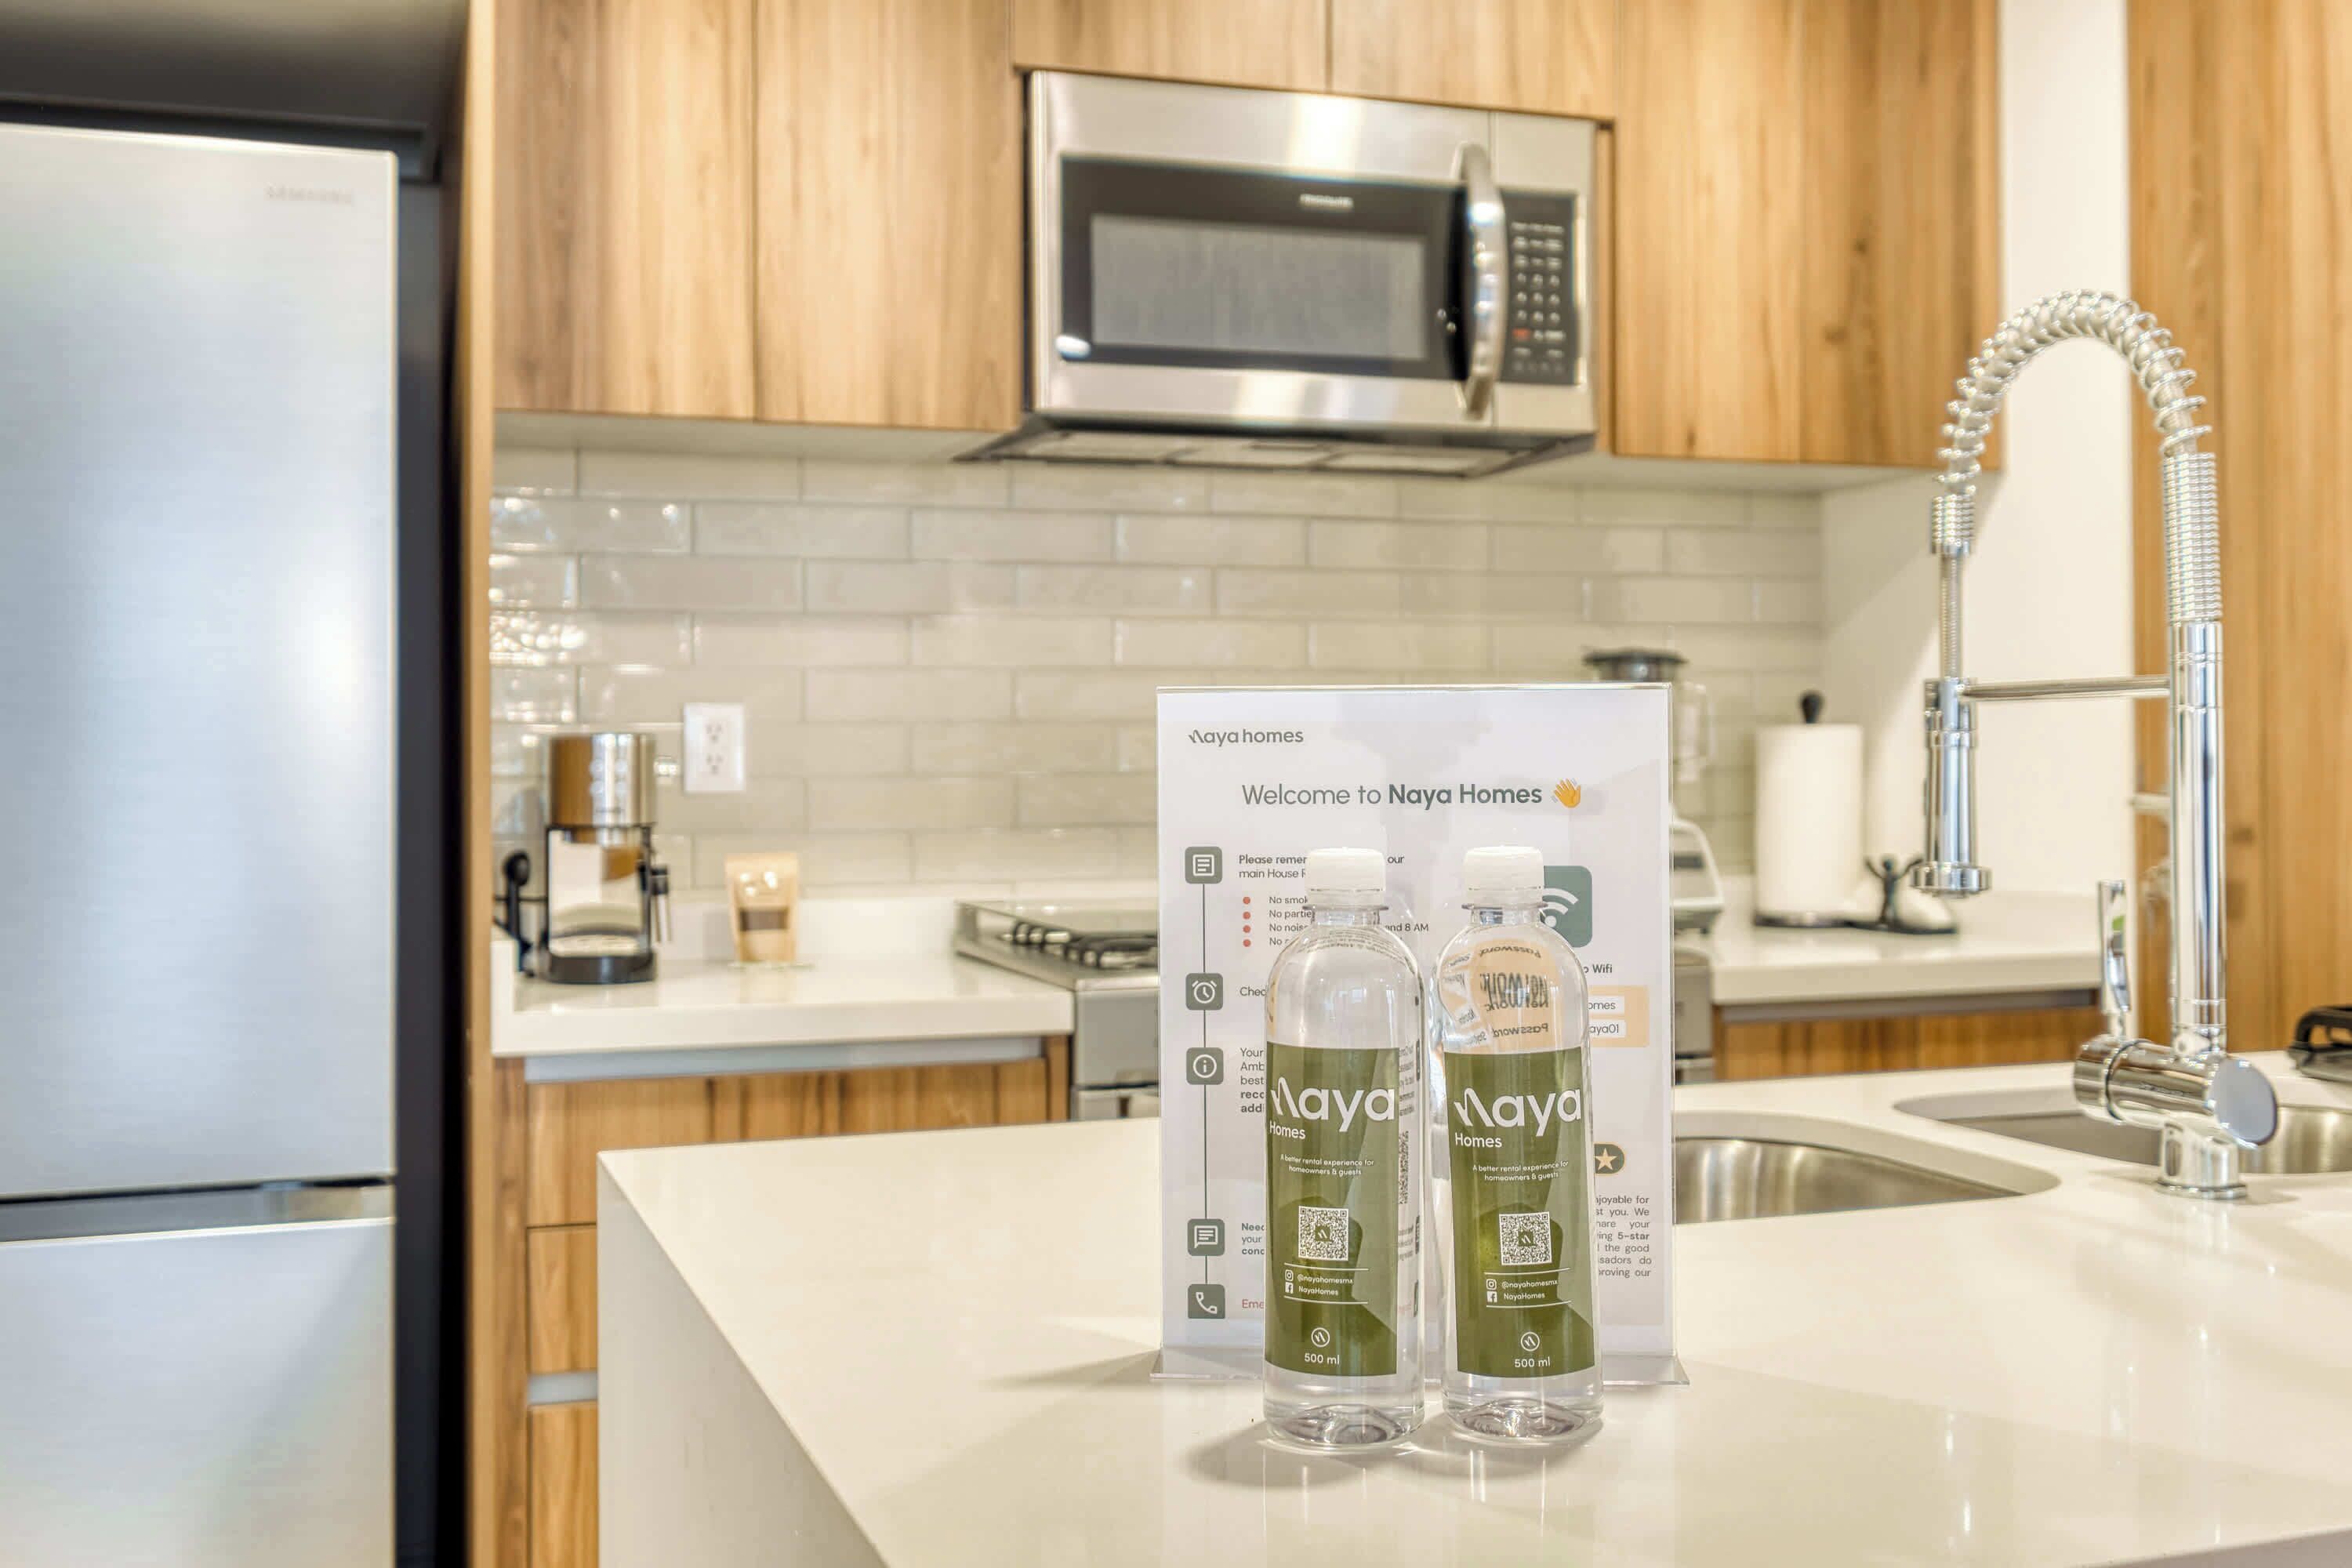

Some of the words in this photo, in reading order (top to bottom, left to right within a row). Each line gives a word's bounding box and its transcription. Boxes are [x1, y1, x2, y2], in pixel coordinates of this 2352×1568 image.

[1242, 728, 1304, 743] homes
[1242, 783, 1350, 805] Welcome
[1358, 785, 1381, 804] to
[1388, 784, 1452, 811] Naya
[1460, 784, 1543, 804] Homes
[1239, 854, 1273, 865] Please
[1239, 869, 1265, 878] main
[1268, 869, 1299, 878] House
[1269, 909, 1282, 918] No
[1404, 923, 1411, 931] 8
[1414, 923, 1429, 931] AM
[1269, 937, 1283, 946] No
[1592, 964, 1613, 974] Wifi
[1240, 1047, 1265, 1058] Your
[1240, 1075, 1265, 1085] best
[1269, 1120, 1306, 1140] Homes
[1455, 1132, 1503, 1148] Homes
[1285, 1154, 1301, 1163] better
[1289, 1165, 1330, 1175] homeowners
[1338, 1168, 1362, 1178] guests
[1523, 1163, 1559, 1171] experience
[1538, 1171, 1559, 1181] guests
[1636, 1195, 1650, 1204] for
[1610, 1209, 1629, 1218] you.
[1634, 1207, 1650, 1216] We
[1241, 1236, 1262, 1245] your
[1617, 1231, 1650, 1240] 5-star
[1605, 1243, 1621, 1252] the
[1625, 1243, 1650, 1254] good
[1639, 1256, 1652, 1265] do
[1298, 1285, 1339, 1296] NayaHomes
[1504, 1292, 1546, 1301] NayaHomes
[1304, 1352, 1323, 1364] 500
[1327, 1354, 1340, 1365] ml
[1514, 1358, 1535, 1368] 500
[1538, 1356, 1551, 1367] ml
